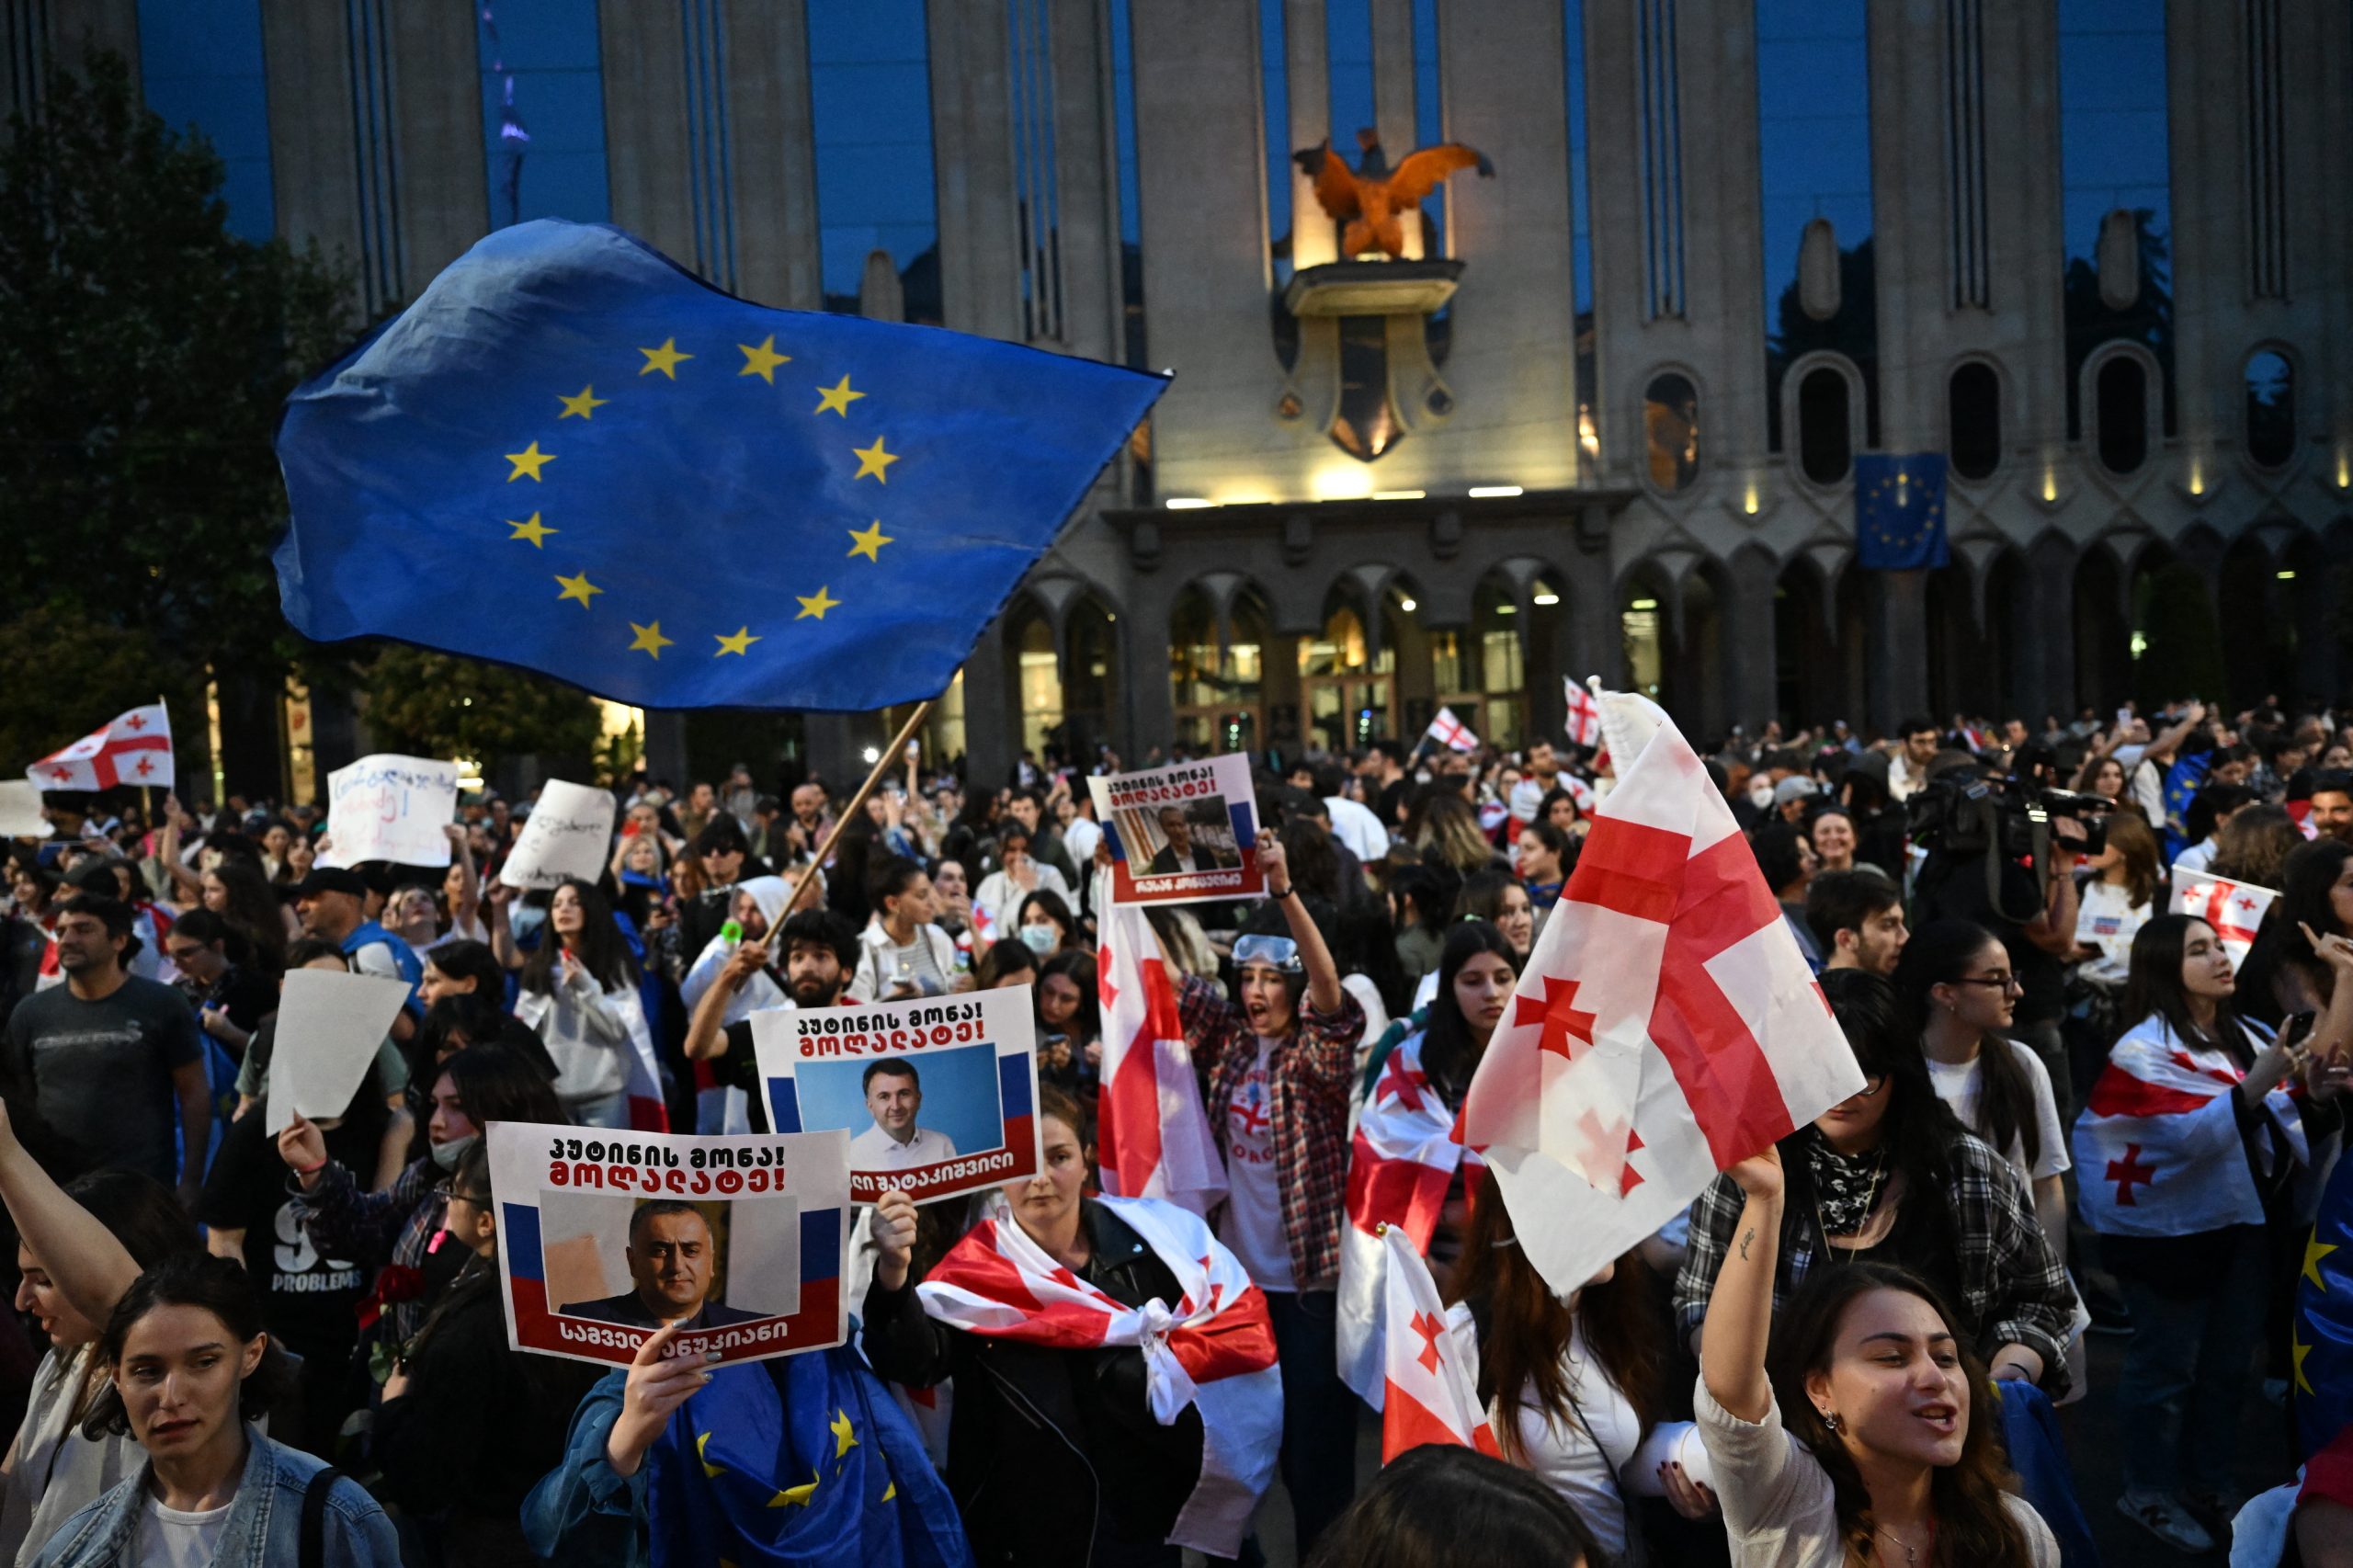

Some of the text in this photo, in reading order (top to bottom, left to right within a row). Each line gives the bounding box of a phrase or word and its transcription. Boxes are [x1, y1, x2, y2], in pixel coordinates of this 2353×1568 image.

[1110, 778, 1217, 807] მოღალატე!
[1167, 766, 1214, 785] მონა!
[798, 1002, 983, 1036] პუტინის მონა!
[799, 1019, 985, 1057] მოღალატე!
[549, 1138, 786, 1169] პუტინის მონა!
[549, 1160, 786, 1195] მოღალატე!
[877, 1152, 1015, 1192] შატაკიშვილი
[272, 1270, 362, 1292] PROBLEMS
[661, 1321, 789, 1358] ანუკიანი
